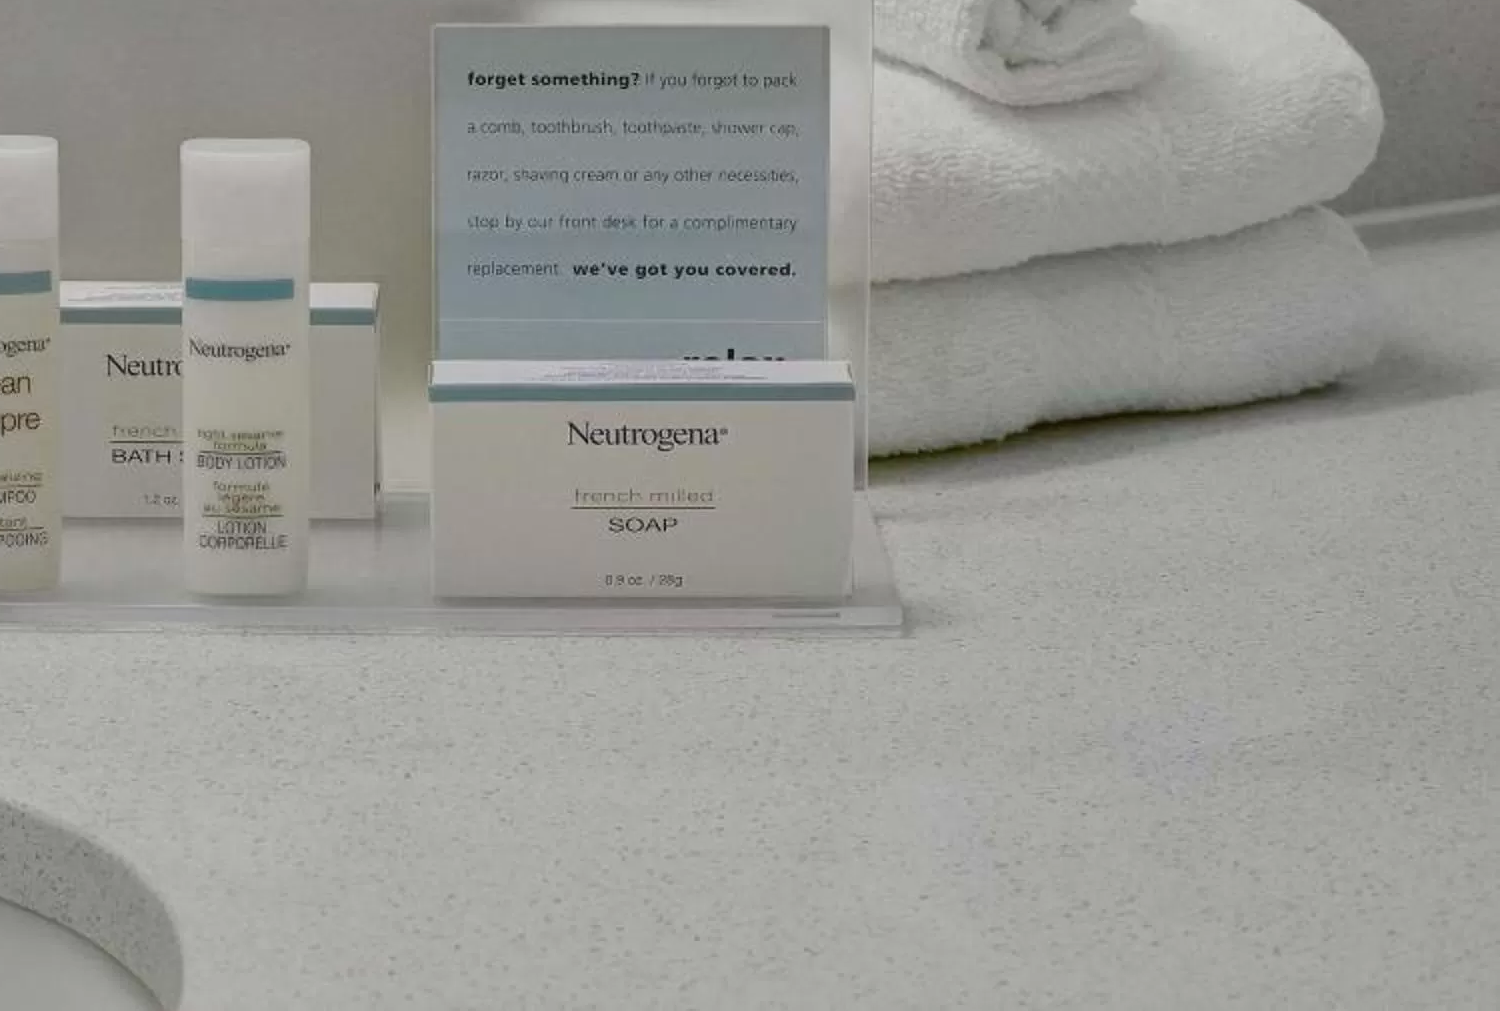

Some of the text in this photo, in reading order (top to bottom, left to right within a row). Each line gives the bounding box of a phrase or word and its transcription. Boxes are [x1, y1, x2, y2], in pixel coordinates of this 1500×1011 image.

[467, 70, 797, 89] forget something? If you forgot to pack
[467, 118, 799, 138] a comb, toothbrush, toothpaste, shower cap,
[467, 168, 799, 185] razor, shaving cream or any other necessities,
[467, 212, 797, 233] stop by our front desk for a complimentary
[573, 262, 629, 276] we've
[635, 263, 668, 280] got
[673, 264, 709, 280] you
[715, 260, 797, 277] covered.
[111, 448, 171, 464] BATH
[197, 454, 232, 470] BODY
[237, 455, 287, 470] LOTION
[575, 488, 714, 503] french milled
[217, 520, 266, 534] LOTION
[608, 516, 678, 533] SOAP
[199, 534, 289, 550] CORPORELLE
